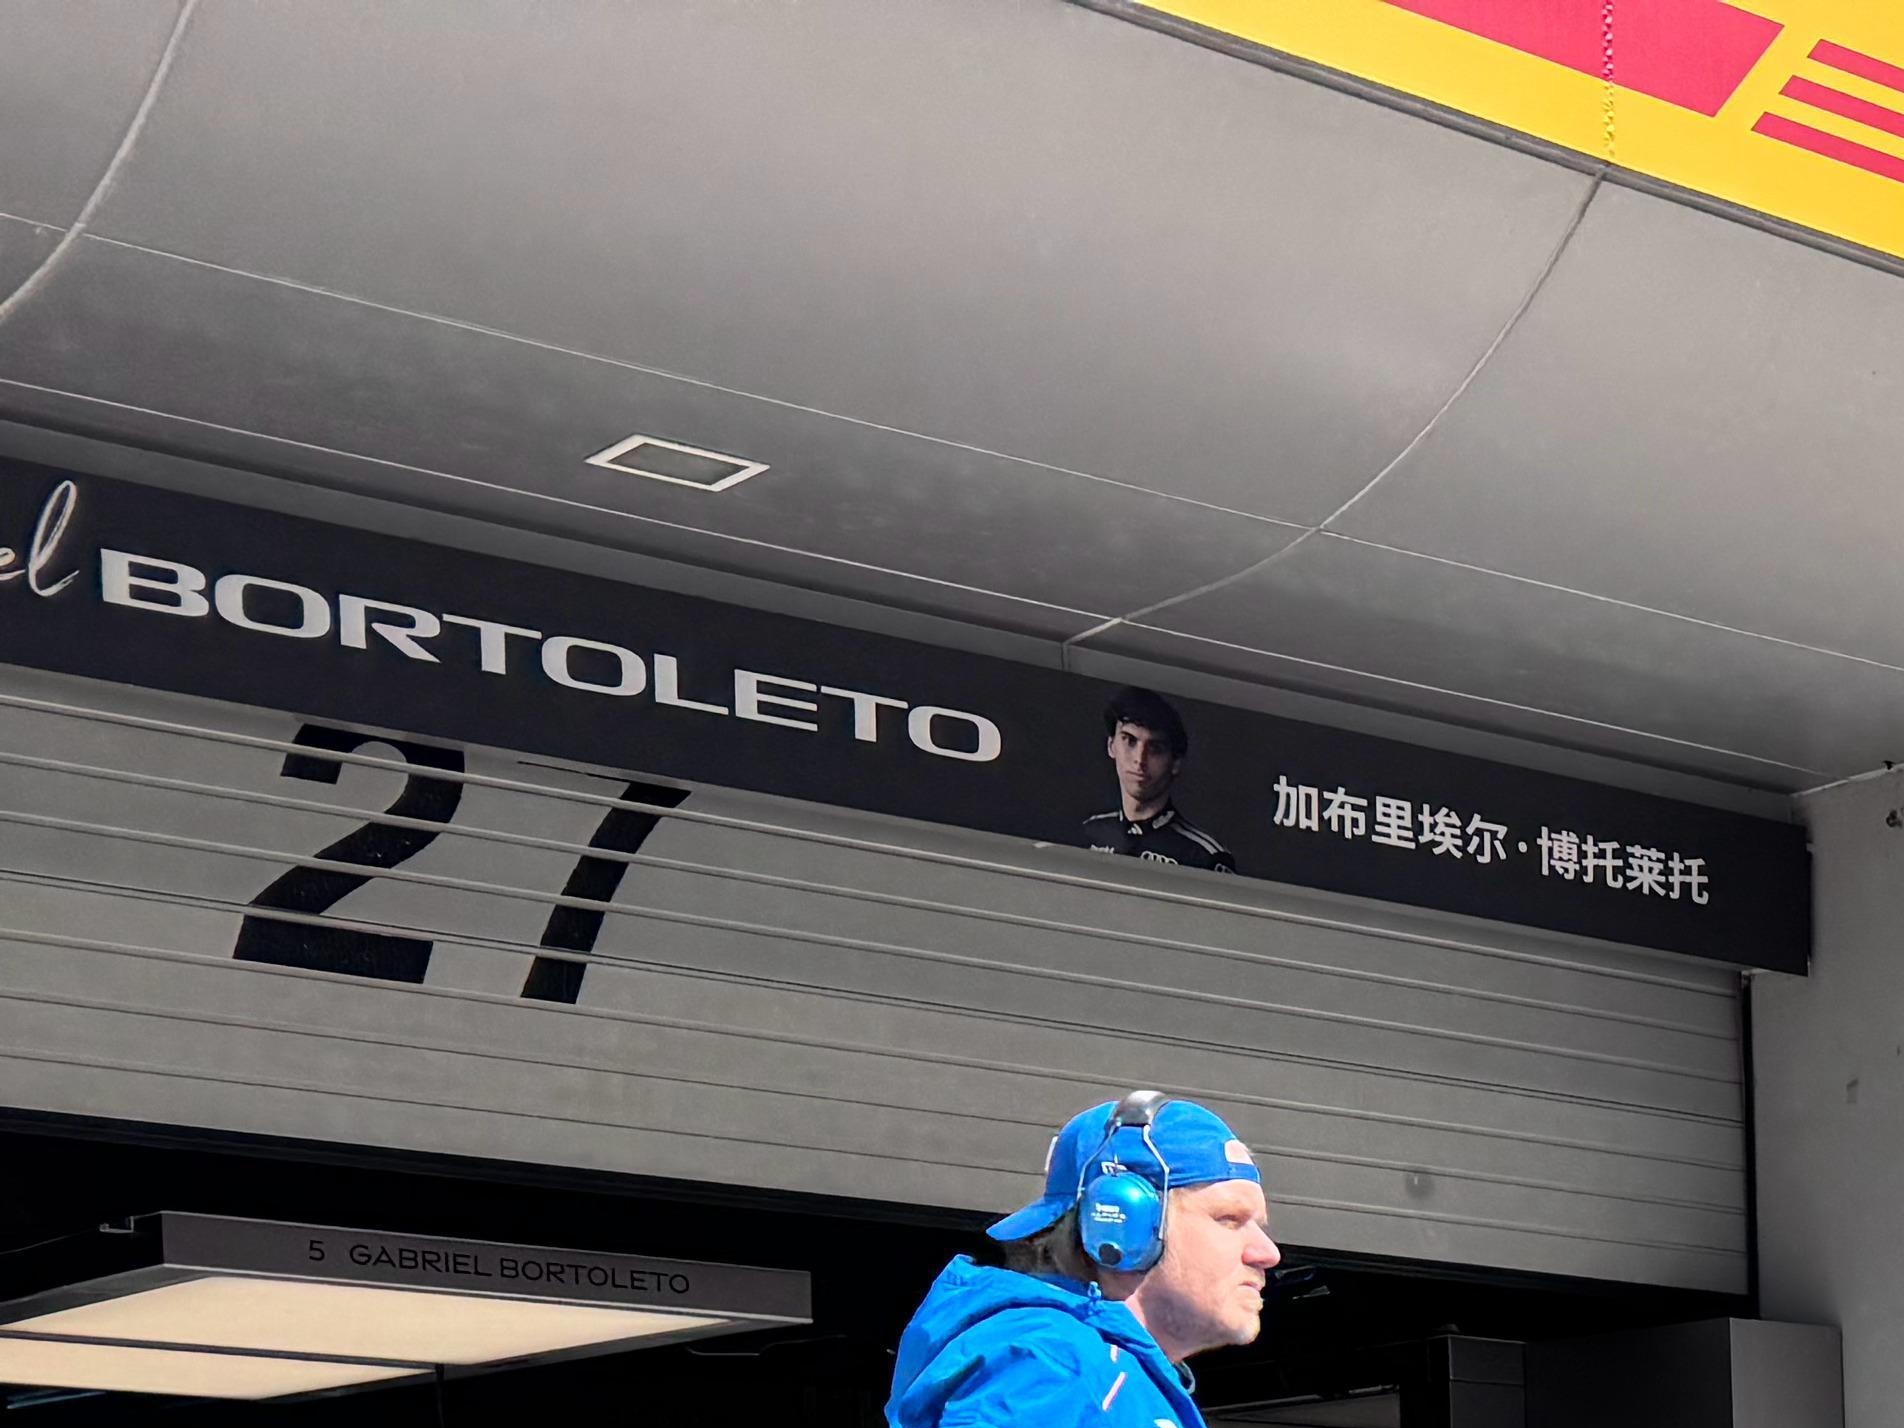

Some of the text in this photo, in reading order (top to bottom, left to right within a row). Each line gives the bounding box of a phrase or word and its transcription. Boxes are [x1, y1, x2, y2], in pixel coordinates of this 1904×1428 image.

[101, 548, 1002, 763] BORTOLETO
[233, 723, 692, 1004] 27
[1273, 775, 1711, 906] 加布里埃尔·博托莱托
[309, 1240, 690, 1295] 5 GABRIEL BORTOLETO
